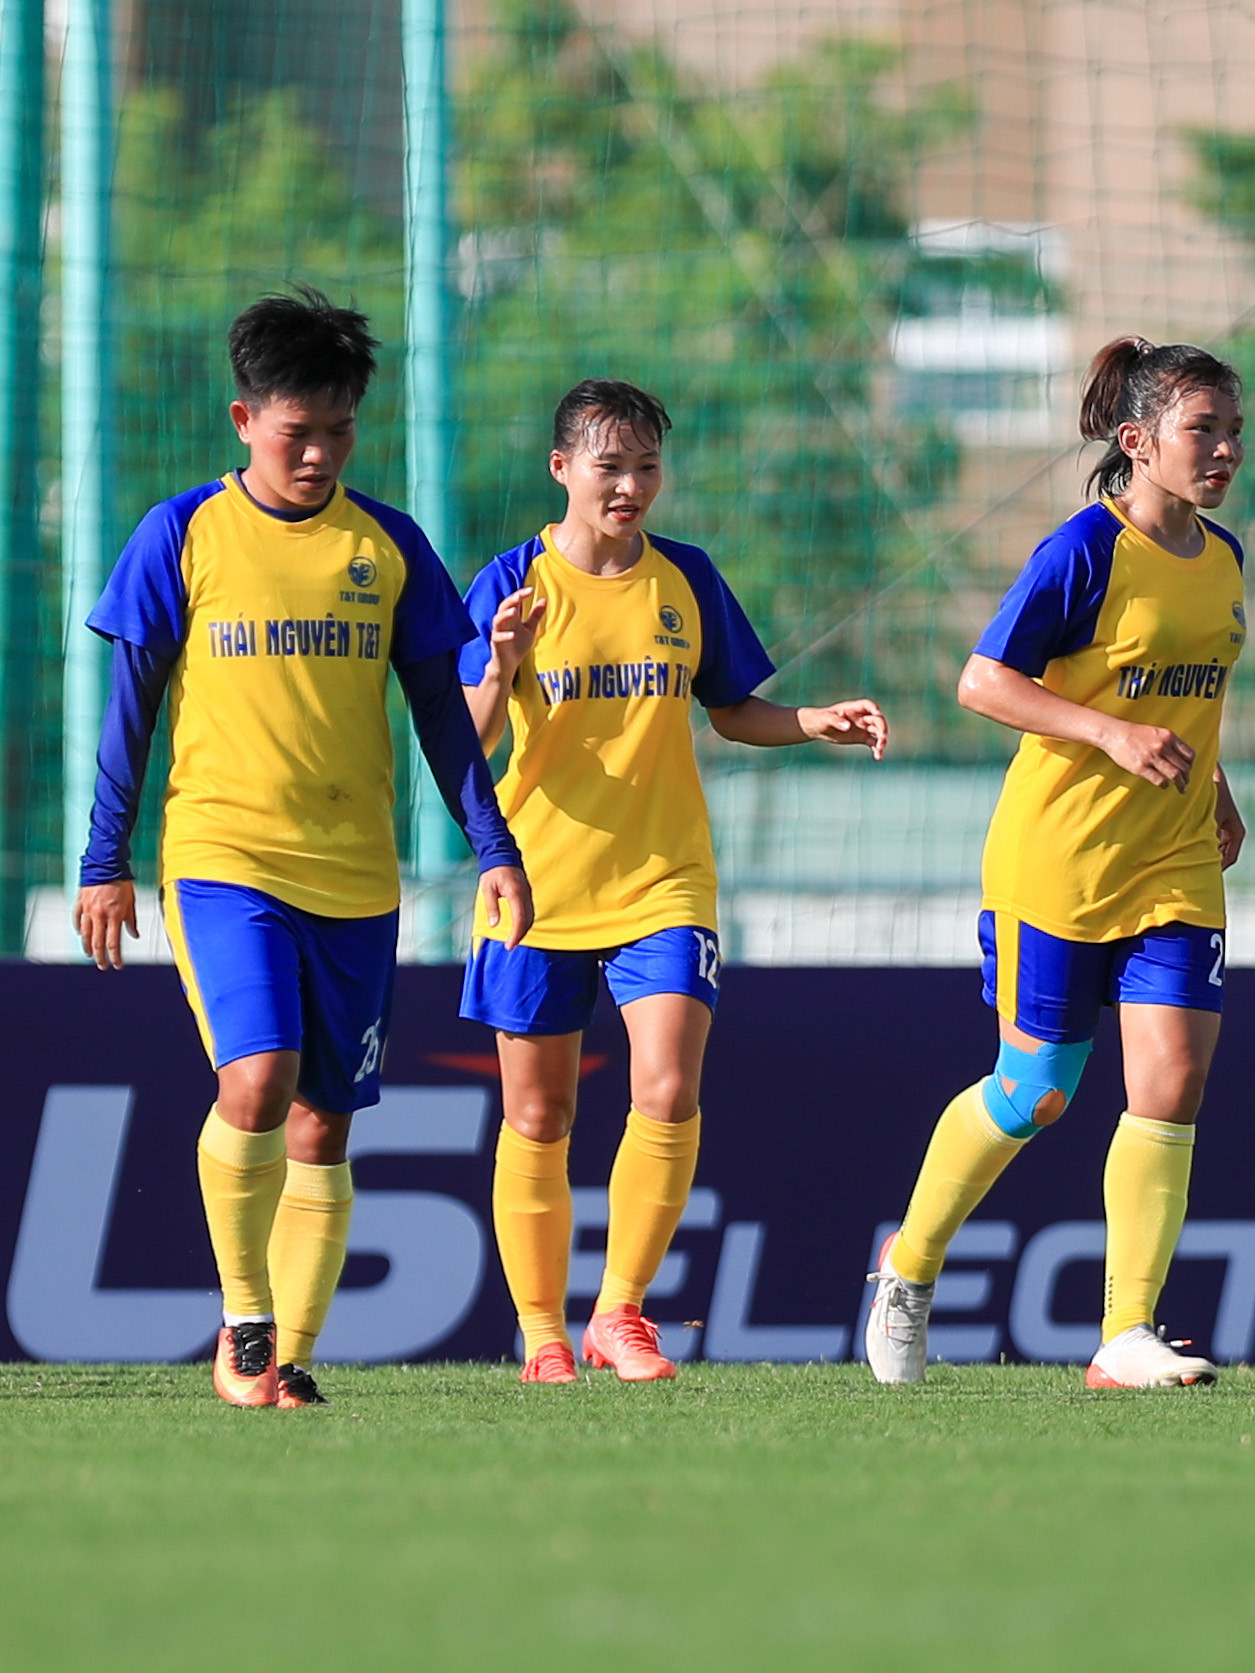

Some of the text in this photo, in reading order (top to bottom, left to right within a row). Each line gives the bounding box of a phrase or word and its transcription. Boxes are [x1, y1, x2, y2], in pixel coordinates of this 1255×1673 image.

[208, 613, 381, 660] THÁI NGUYÊN T&T
[537, 660, 582, 706] THÁI
[588, 656, 669, 700] NGUYÊN
[692, 930, 718, 990] 12
